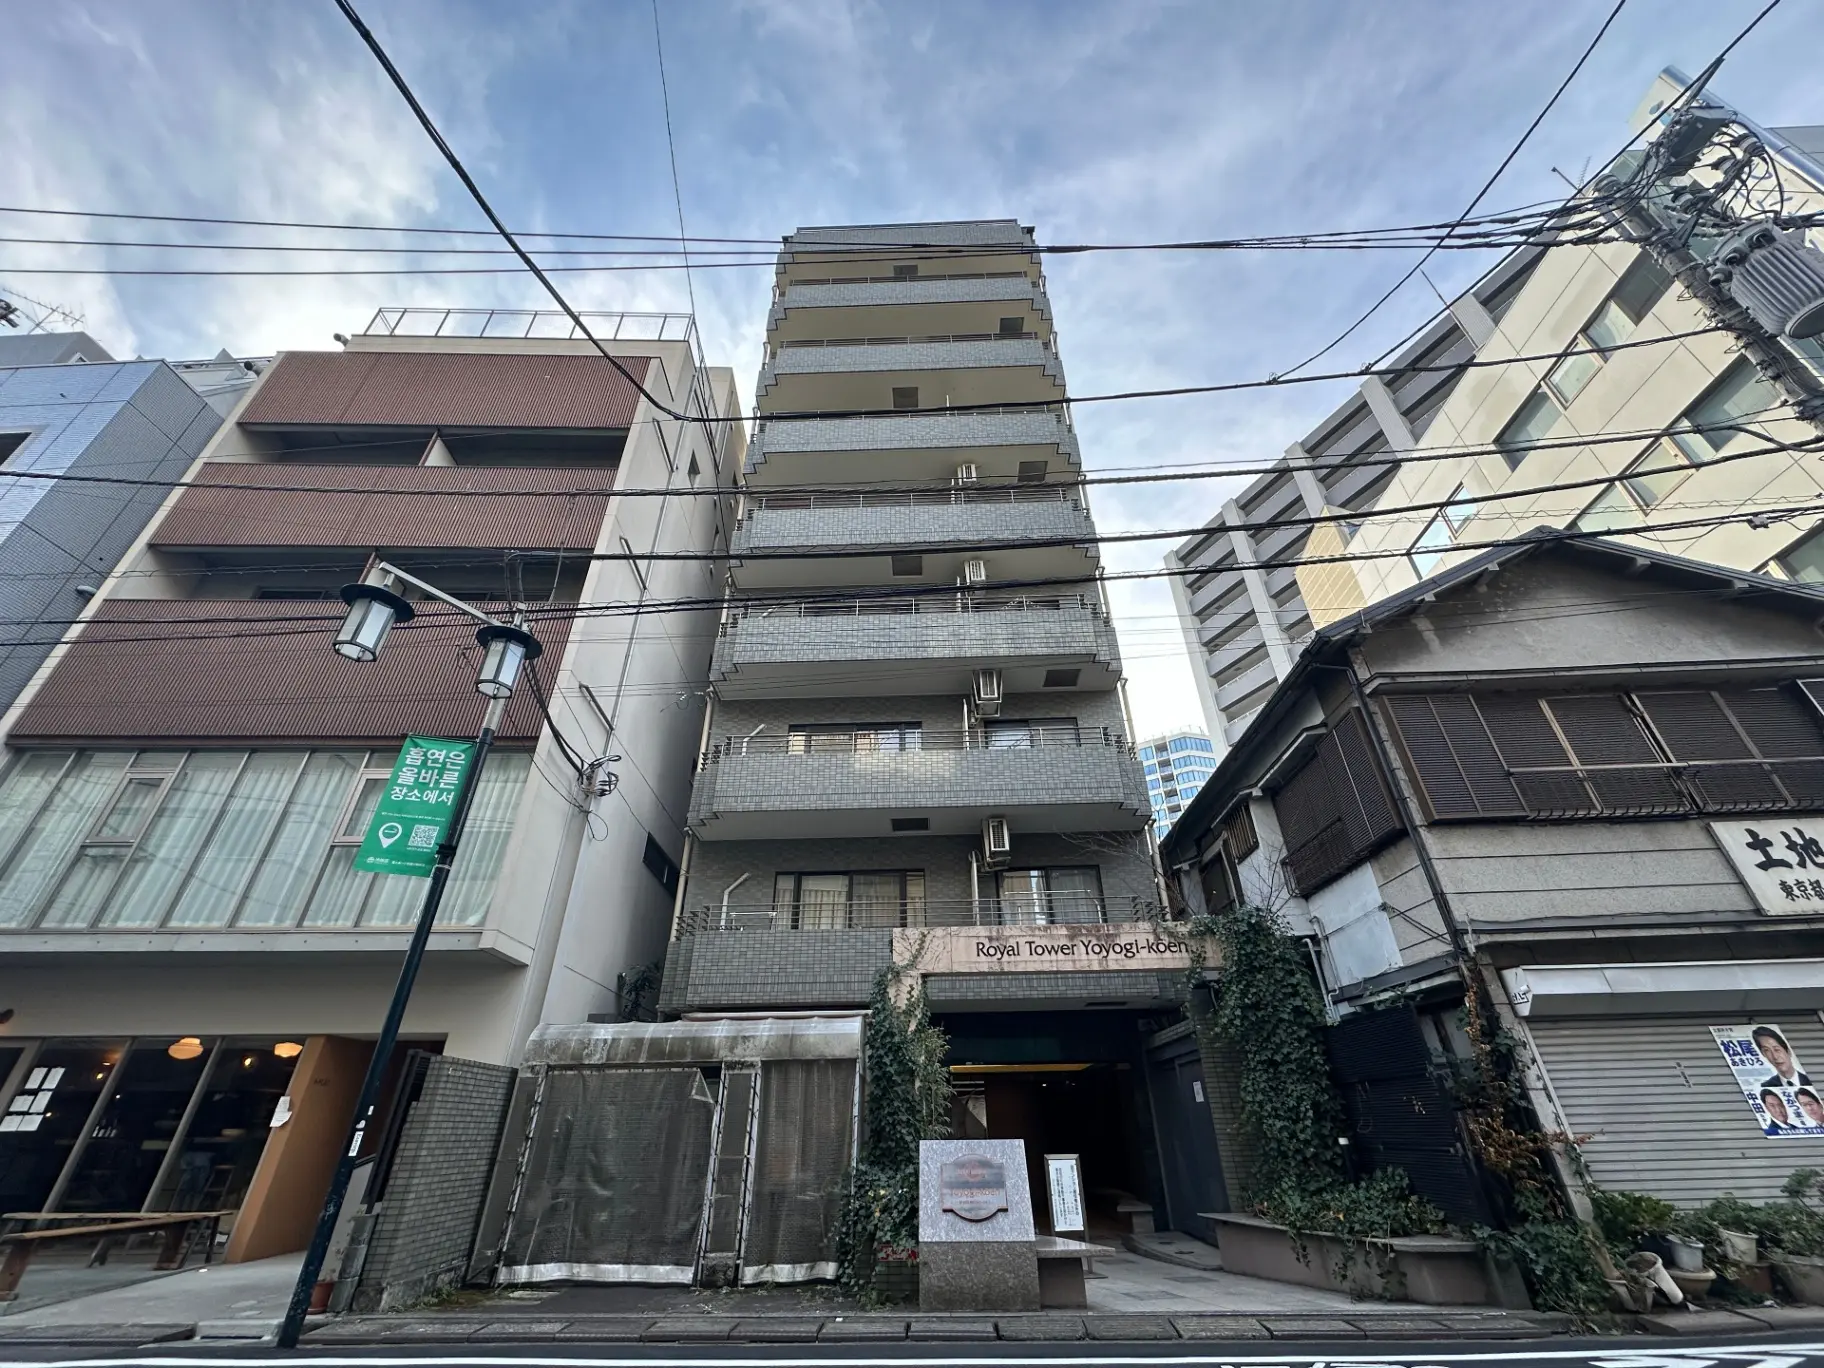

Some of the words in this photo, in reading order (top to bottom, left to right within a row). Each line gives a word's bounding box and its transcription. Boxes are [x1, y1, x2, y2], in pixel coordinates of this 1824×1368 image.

[404, 747, 466, 770] 흡연은
[396, 766, 459, 789] 올바른
[390, 786, 455, 806] 장소에서
[1744, 827, 1824, 871] 土地
[976, 941, 1020, 960] Royal
[1025, 940, 1077, 957] Tower
[1720, 1040, 1759, 1058] 松尾
[1730, 1057, 1764, 1067] あきひろ
